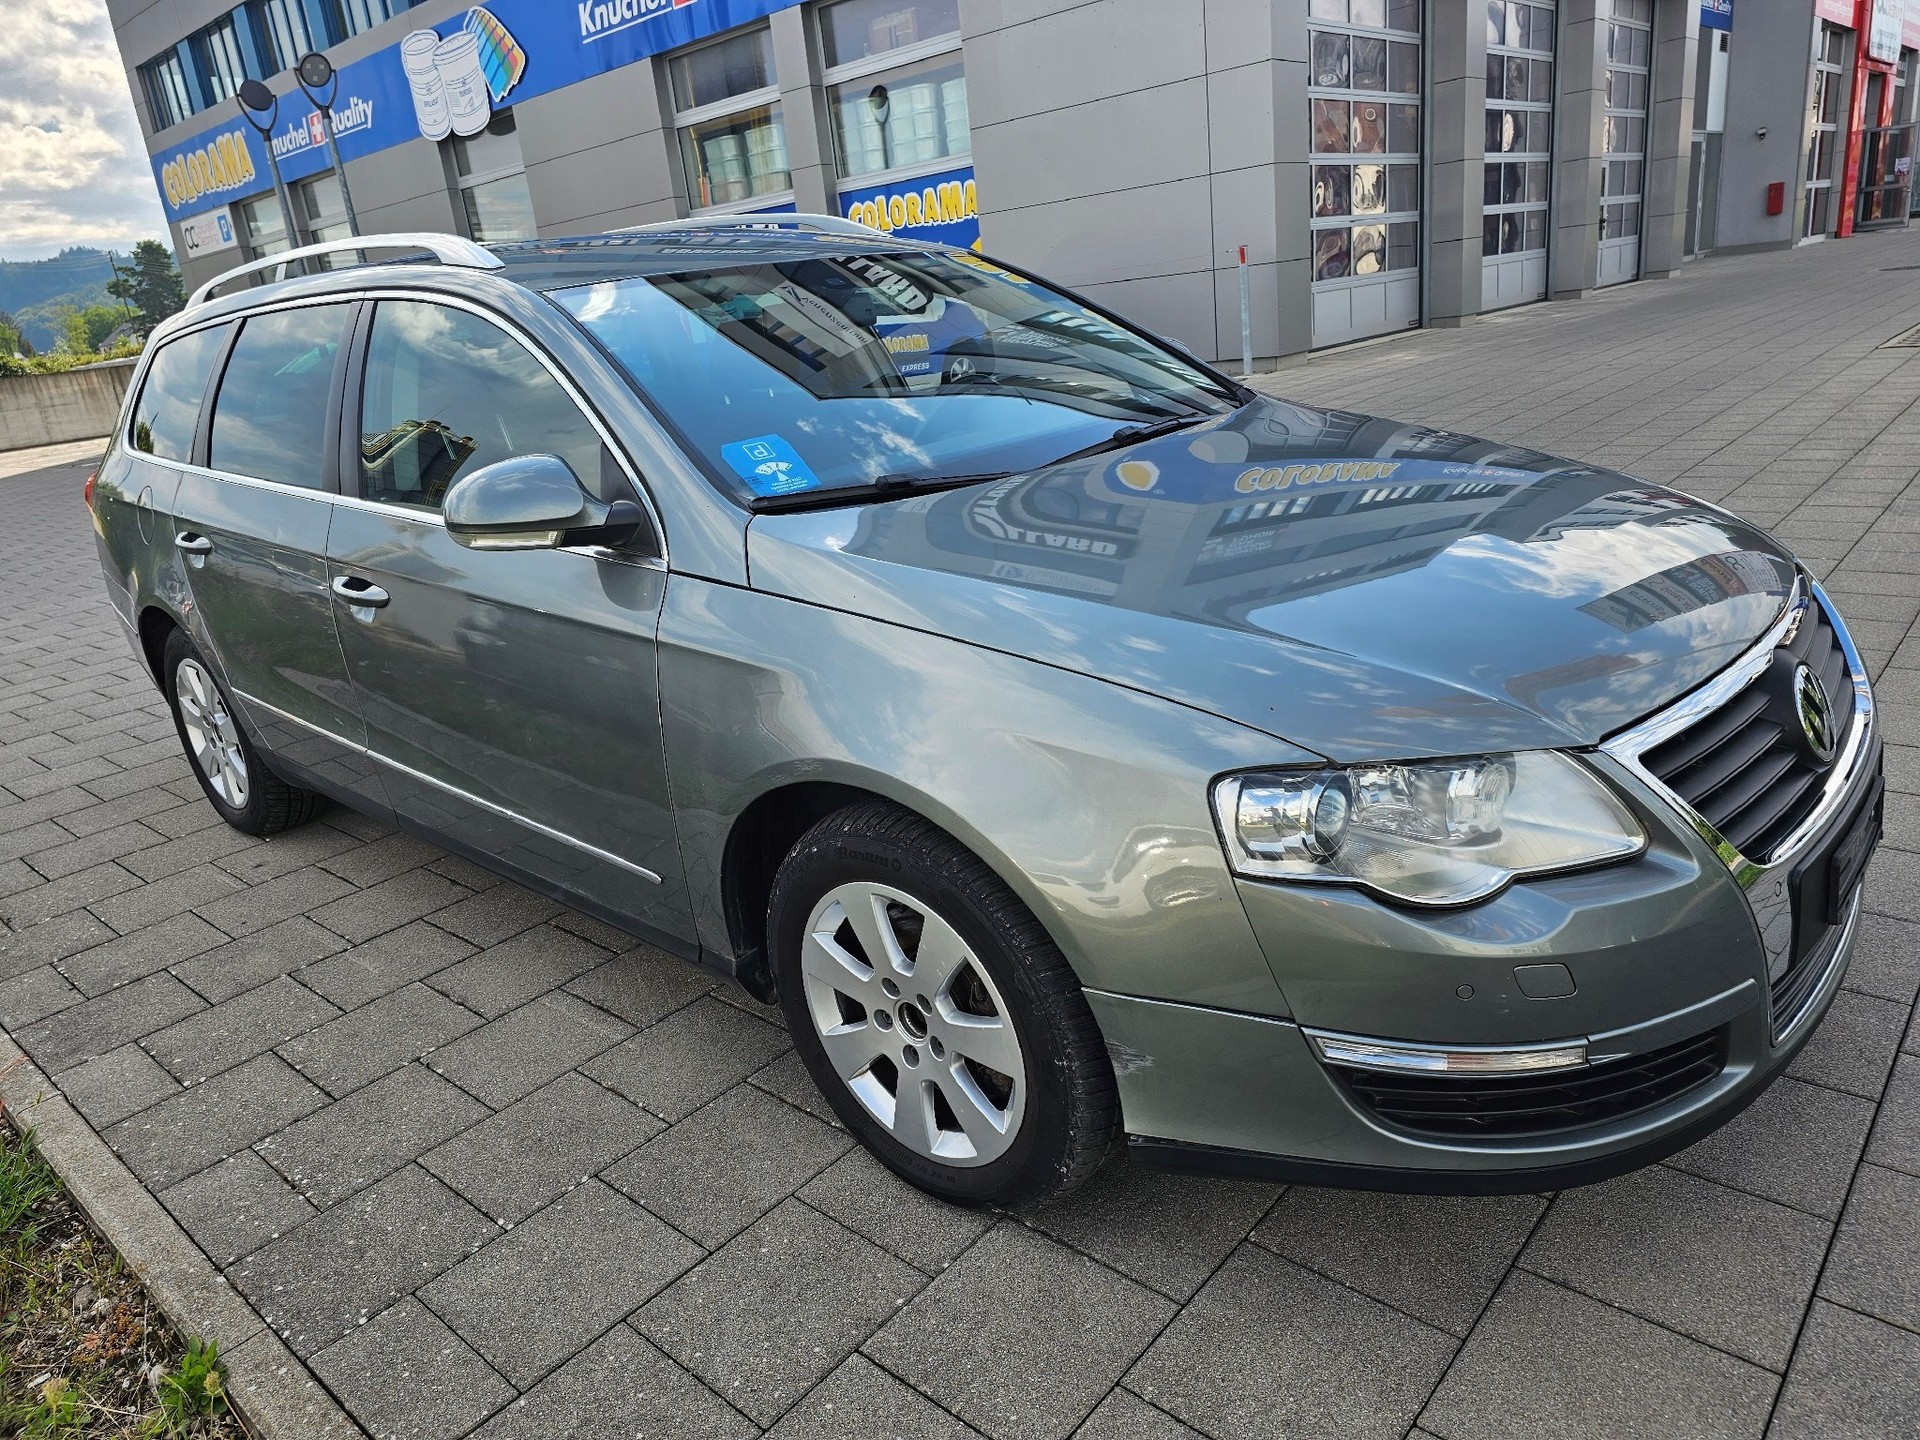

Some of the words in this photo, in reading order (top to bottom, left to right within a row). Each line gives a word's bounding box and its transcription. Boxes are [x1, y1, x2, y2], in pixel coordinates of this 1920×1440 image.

[578, 0, 668, 36] Knuche
[267, 116, 310, 157] nuchel
[162, 131, 254, 209] COLORAMA
[848, 180, 979, 232] COLORAMA
[901, 362, 930, 372] EXPRESS
